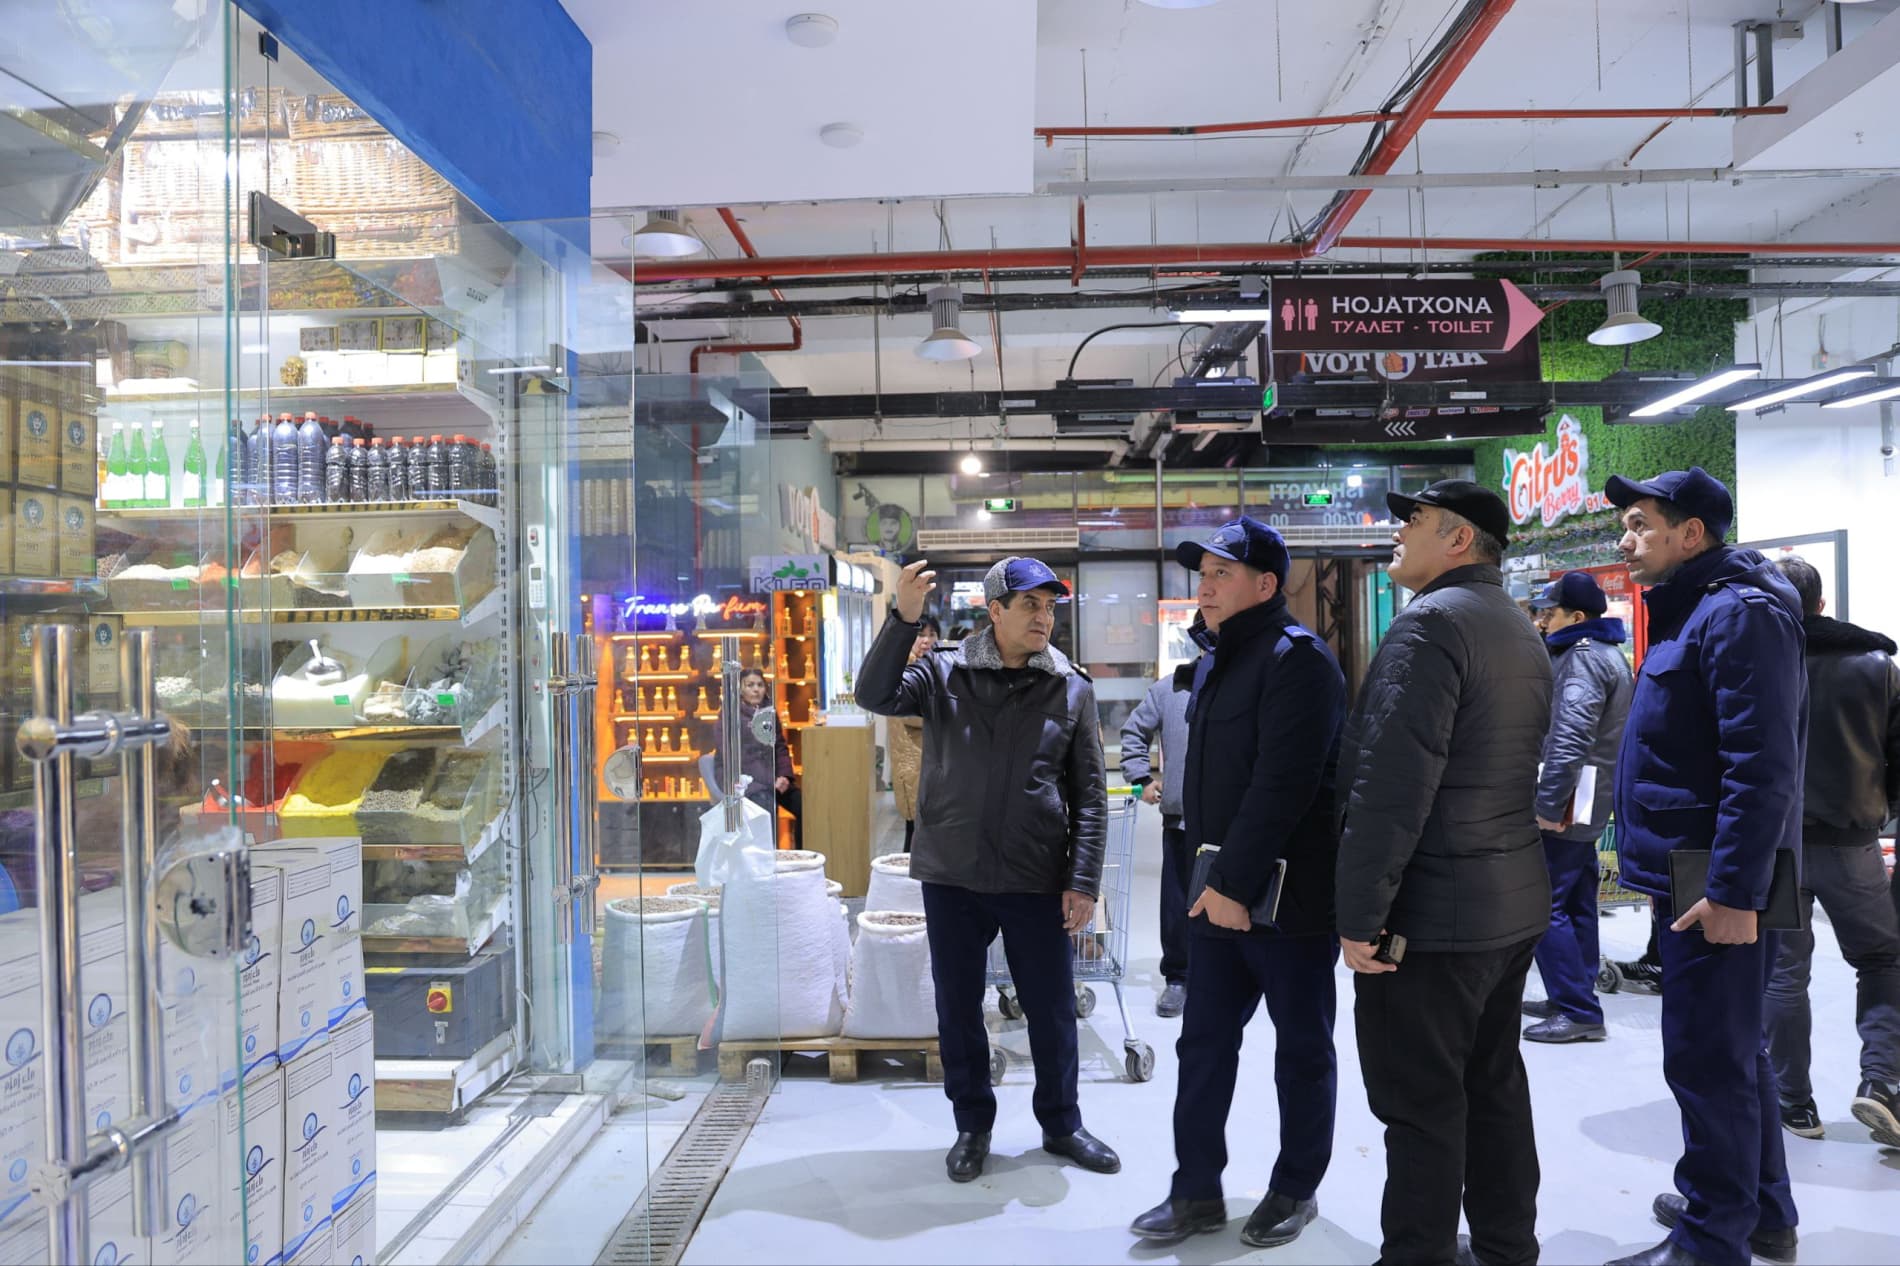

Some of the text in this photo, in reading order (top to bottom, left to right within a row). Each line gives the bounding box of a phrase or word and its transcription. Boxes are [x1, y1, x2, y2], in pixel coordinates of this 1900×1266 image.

[1332, 296, 1493, 314] HOJATXONA
[1305, 352, 1371, 373] VOT
[1510, 434, 1579, 520] Citrus
